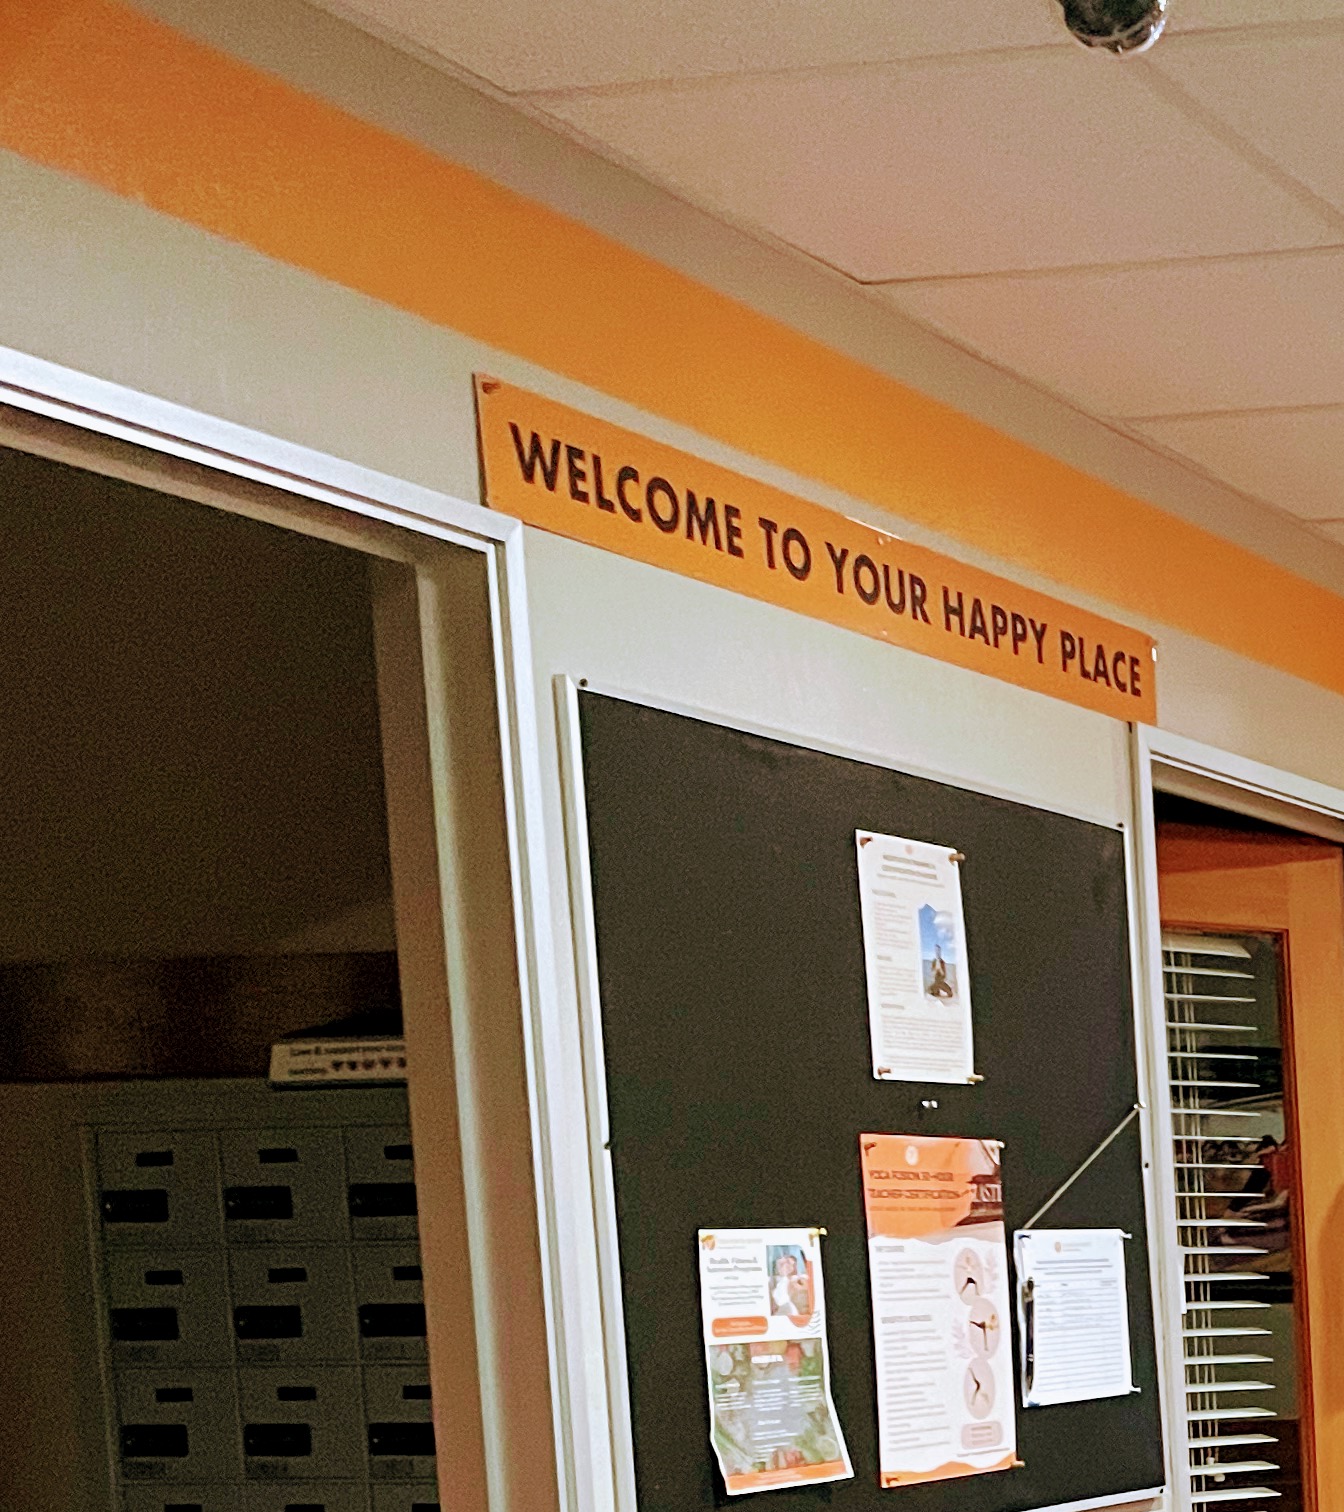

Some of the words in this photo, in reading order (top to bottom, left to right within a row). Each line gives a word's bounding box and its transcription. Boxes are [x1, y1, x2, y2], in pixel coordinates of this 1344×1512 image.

[508, 422, 744, 559] WELCOME
[758, 516, 812, 581] TO
[825, 541, 931, 625] YOUR
[942, 585, 1047, 664] HAPPY
[1060, 629, 1142, 697] PLACE
